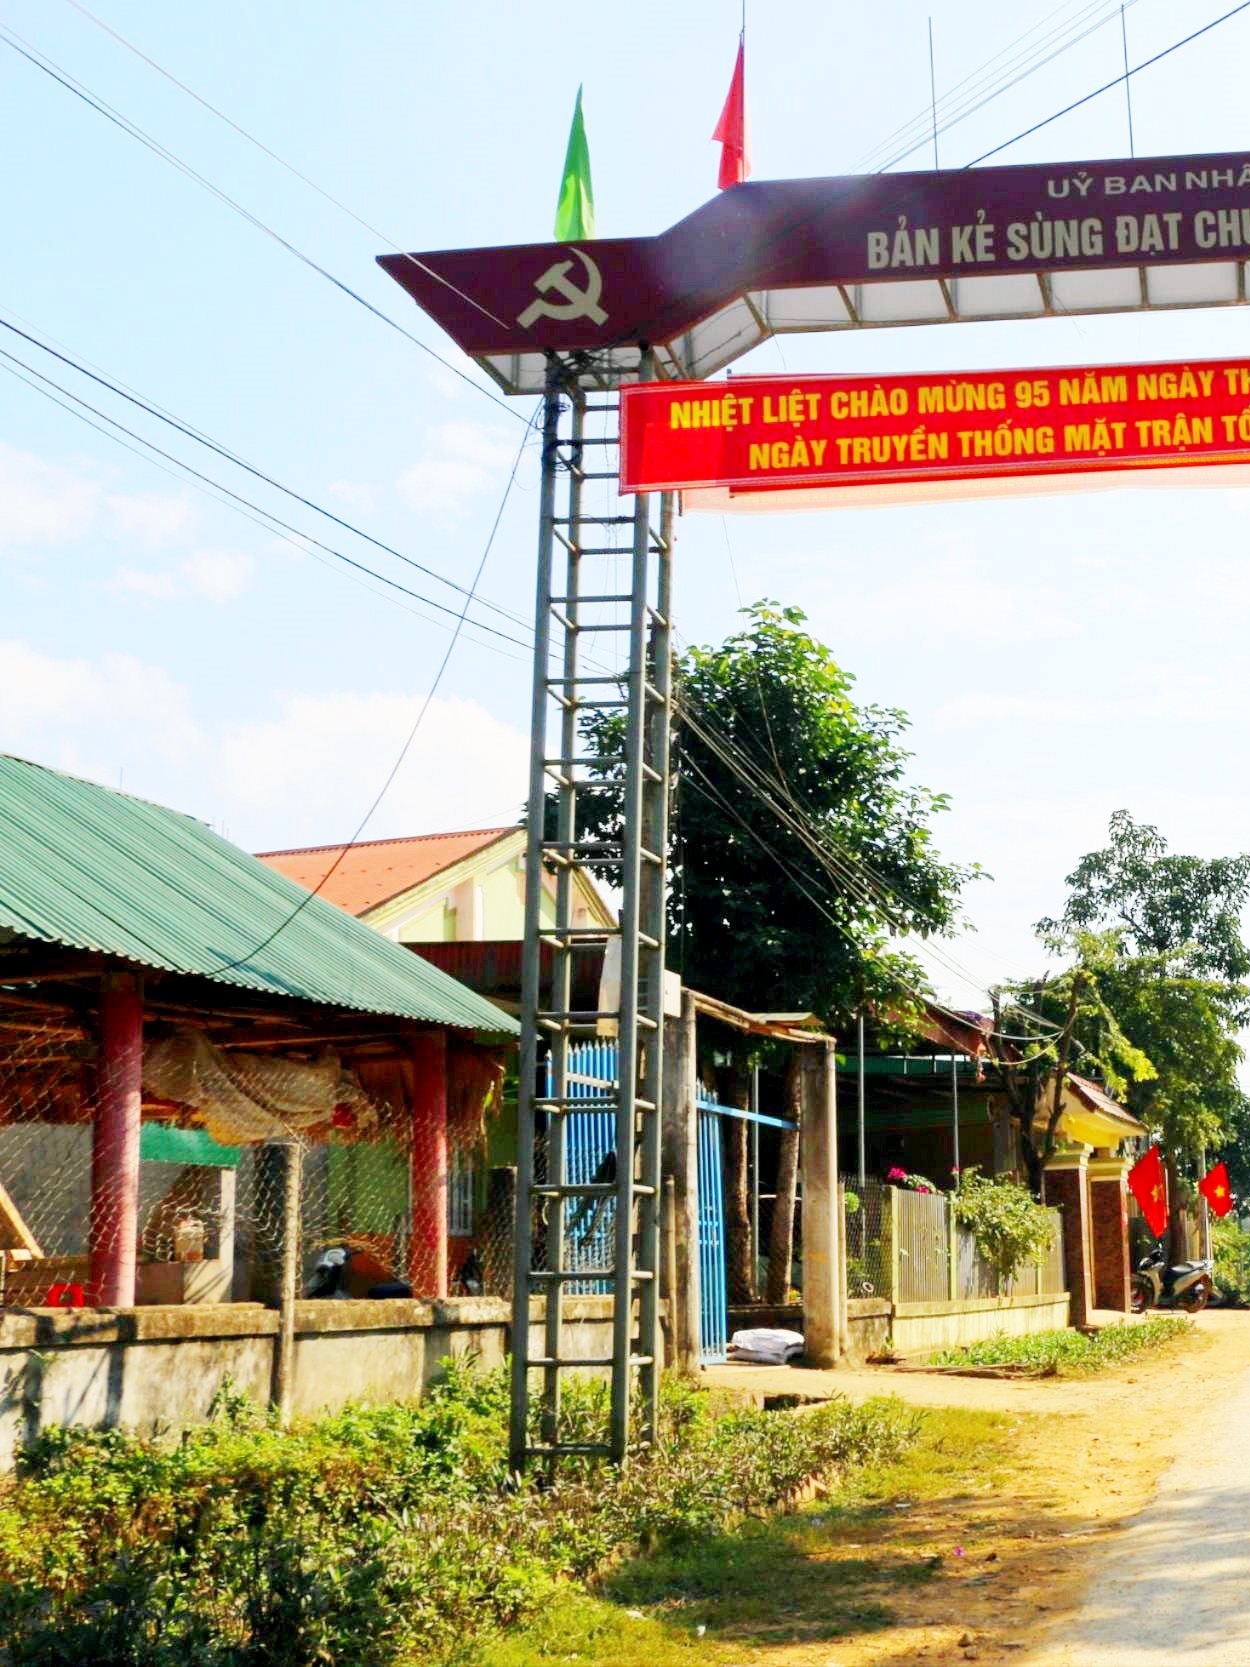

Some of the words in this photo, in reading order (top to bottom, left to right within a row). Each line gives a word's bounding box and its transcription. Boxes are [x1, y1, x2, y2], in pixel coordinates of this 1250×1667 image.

[1105, 173, 1177, 195] BAN
[868, 216, 939, 269] BẢN
[952, 209, 995, 263] KẺ
[1006, 213, 1103, 258] SÙNG
[1116, 213, 1182, 255] ĐẠT
[670, 393, 753, 431] NHIỆT
[763, 389, 821, 427] LIỆT
[831, 382, 908, 419] CHÀO
[919, 379, 1006, 412] MỪNG
[1016, 380, 1050, 407] 95
[1060, 368, 1128, 404] NĂM
[1137, 365, 1214, 401] NGÀY
[749, 434, 828, 470] NGÀY
[836, 425, 949, 465] TRUYỀN
[957, 418, 1055, 457] THỐNG
[1064, 417, 1125, 457] MẶT
[1136, 413, 1213, 451] TRẬN
